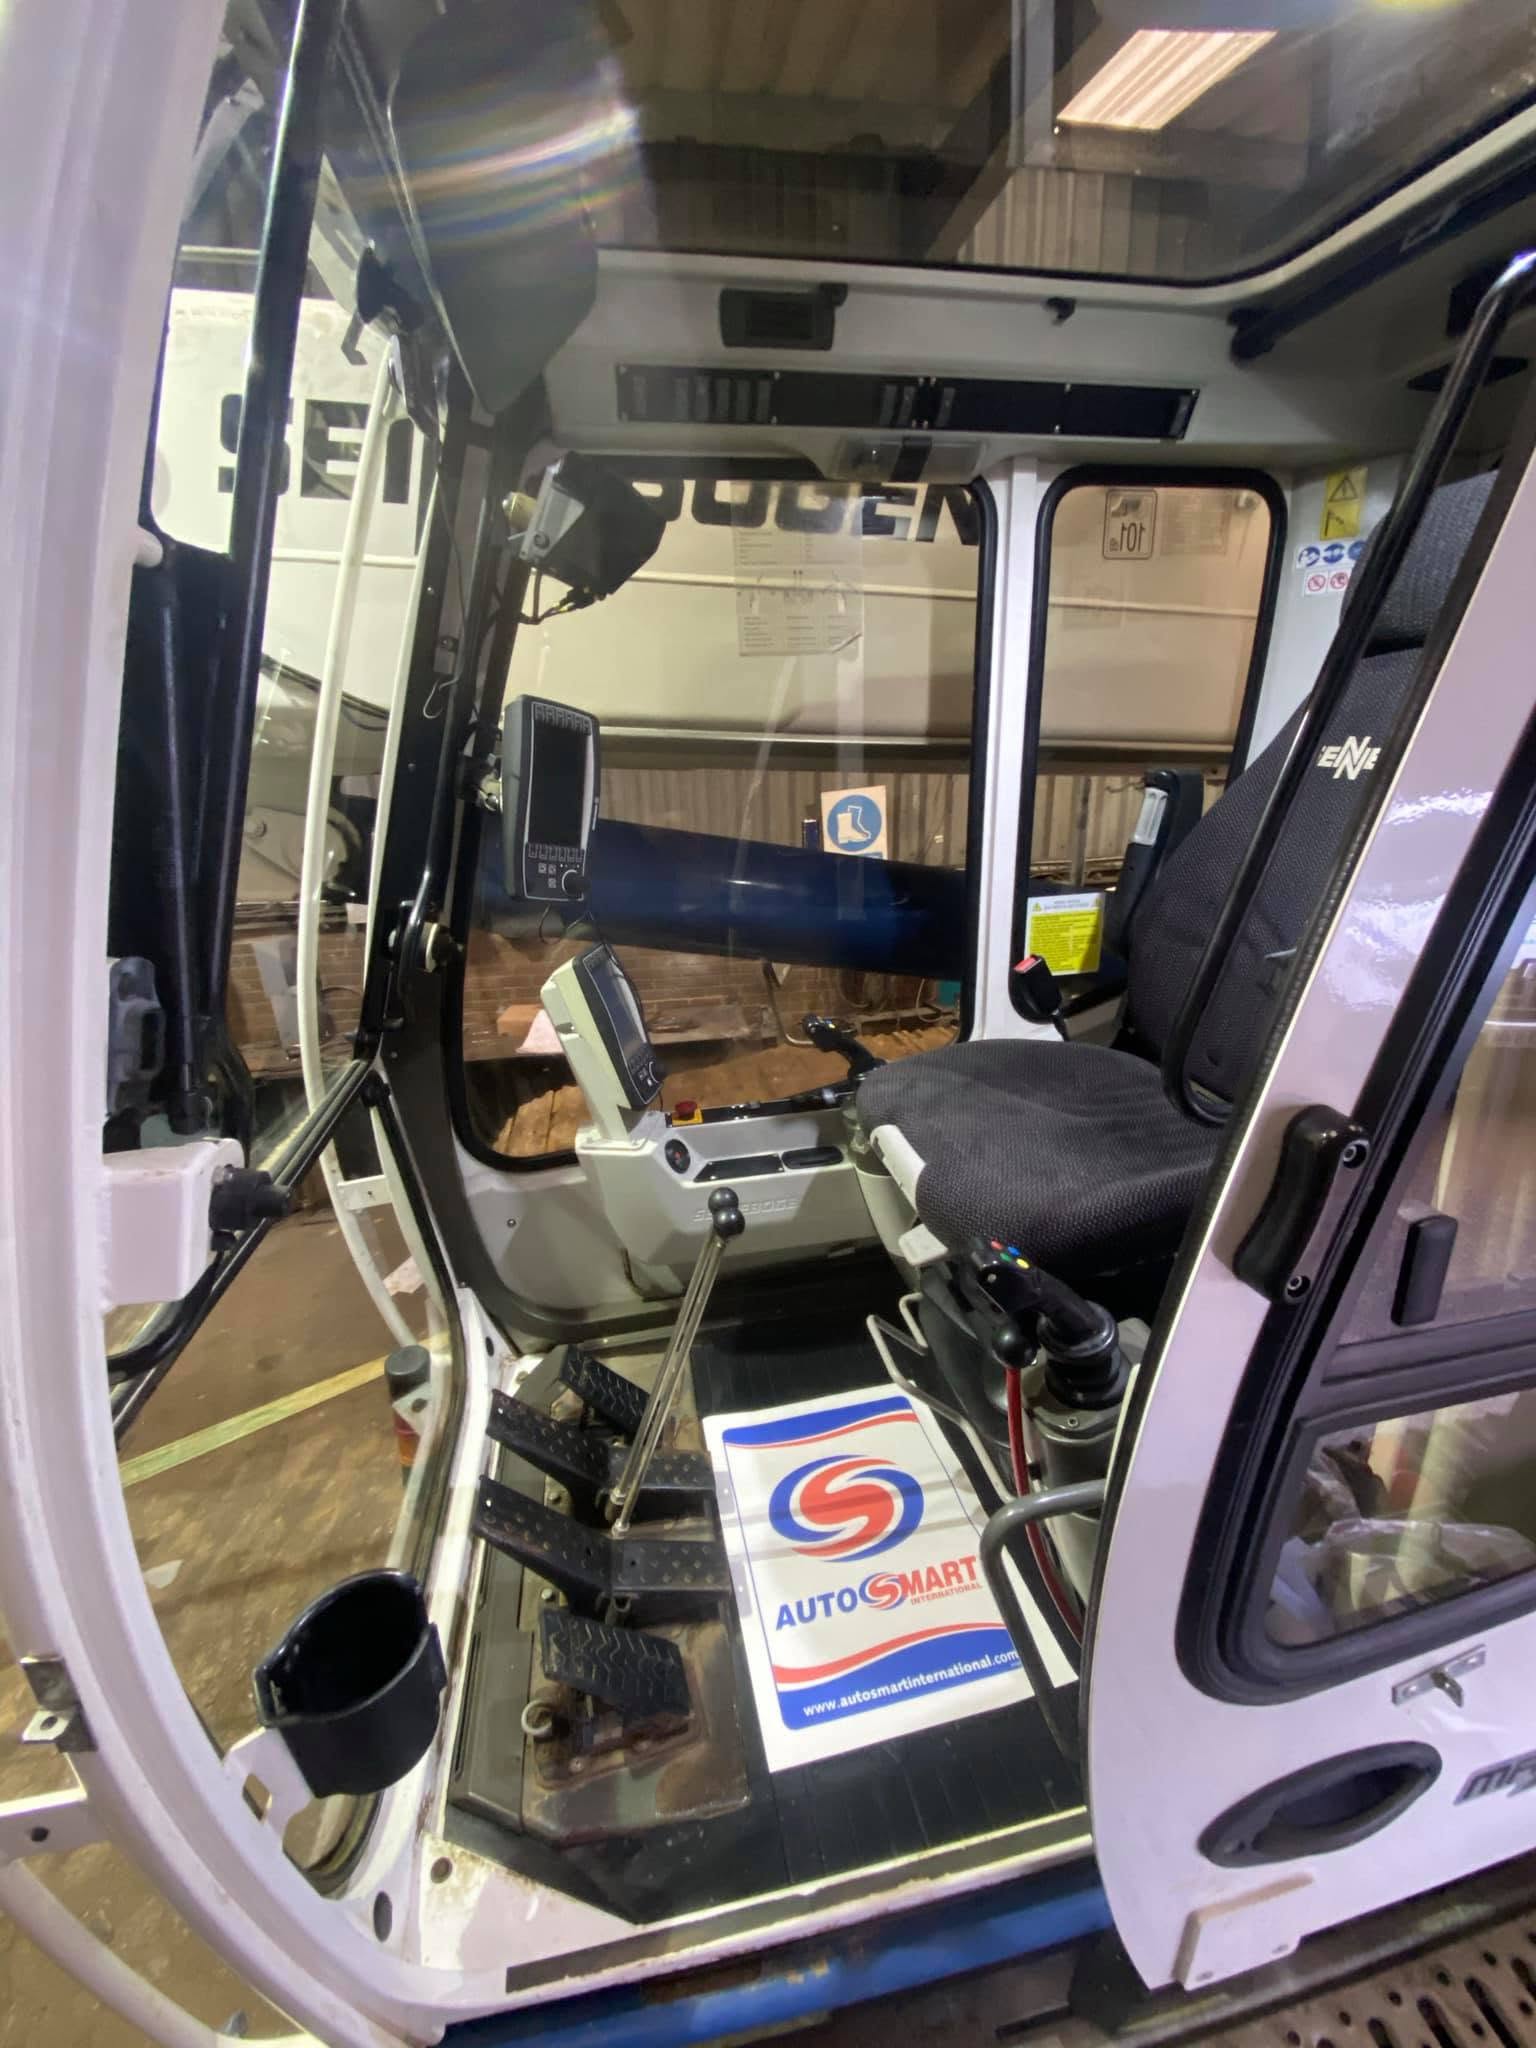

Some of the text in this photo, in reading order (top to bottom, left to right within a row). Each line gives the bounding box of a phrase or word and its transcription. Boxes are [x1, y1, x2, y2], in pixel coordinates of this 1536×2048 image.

[776, 1556, 977, 1631] AUTOSMART
[910, 1583, 982, 1606] INTERNATIONAL
[803, 1650, 1021, 1718] www.autosmartinternational.com
